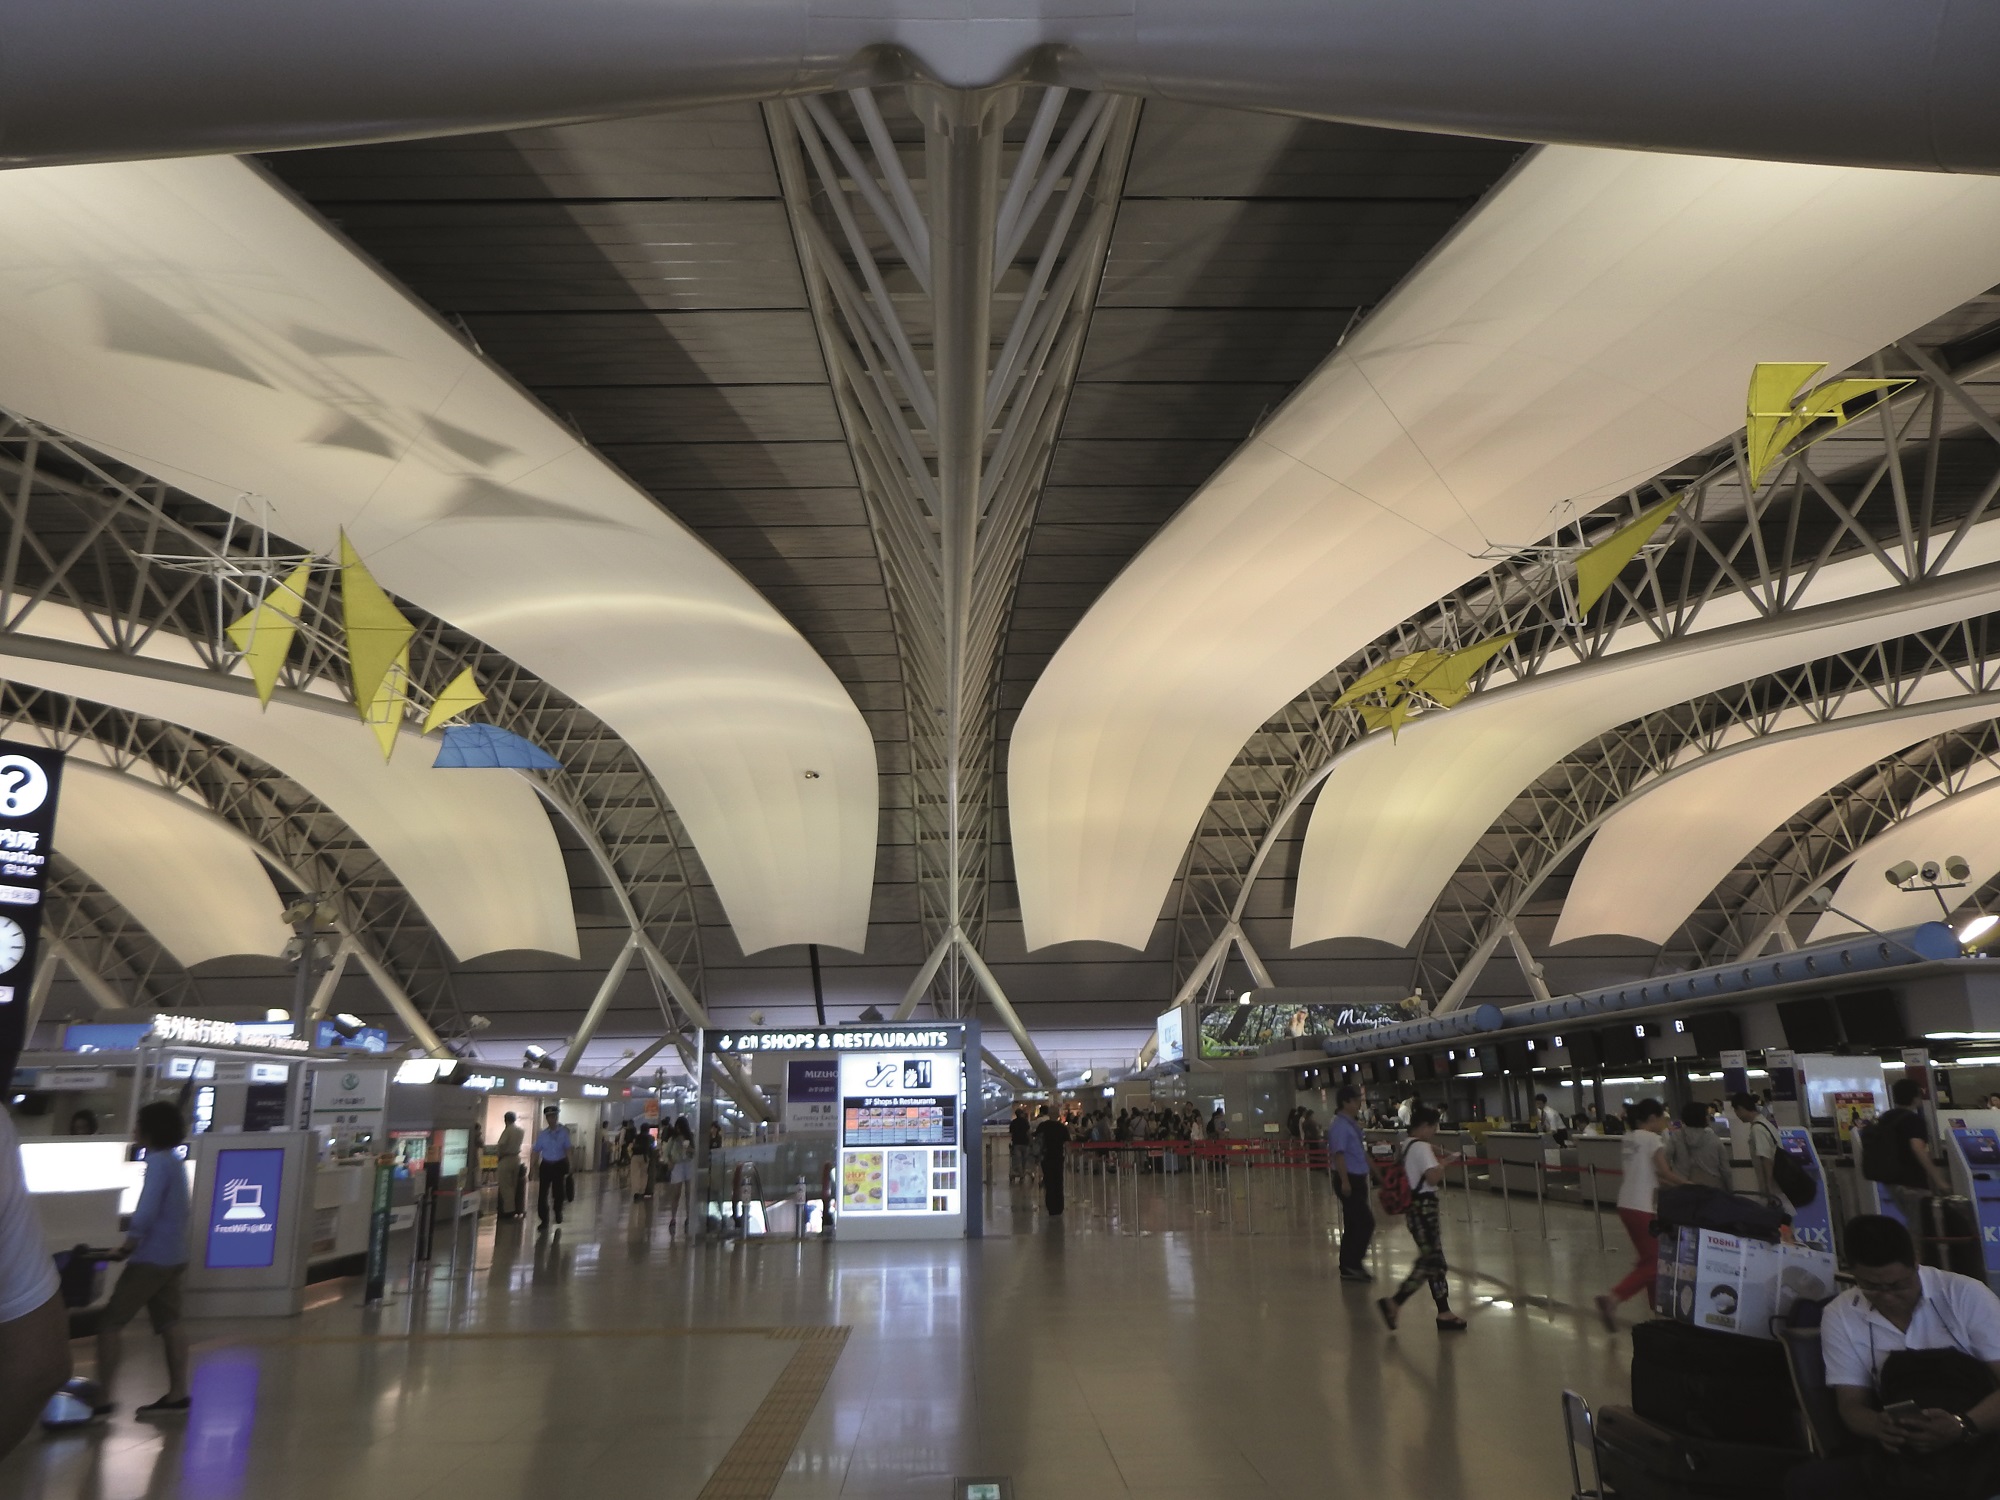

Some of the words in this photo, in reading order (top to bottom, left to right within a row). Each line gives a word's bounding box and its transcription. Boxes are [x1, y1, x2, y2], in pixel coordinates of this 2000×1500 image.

[1337, 1009, 1401, 1029] Malaysia
[761, 1034, 815, 1049] SHOPS
[817, 1034, 830, 1048] &
[833, 1032, 948, 1048] RESTAURANTS
[874, 1098, 893, 1106] Shops
[900, 1097, 937, 1105] Restaurants
[1706, 1235, 1741, 1249] TOSHI
